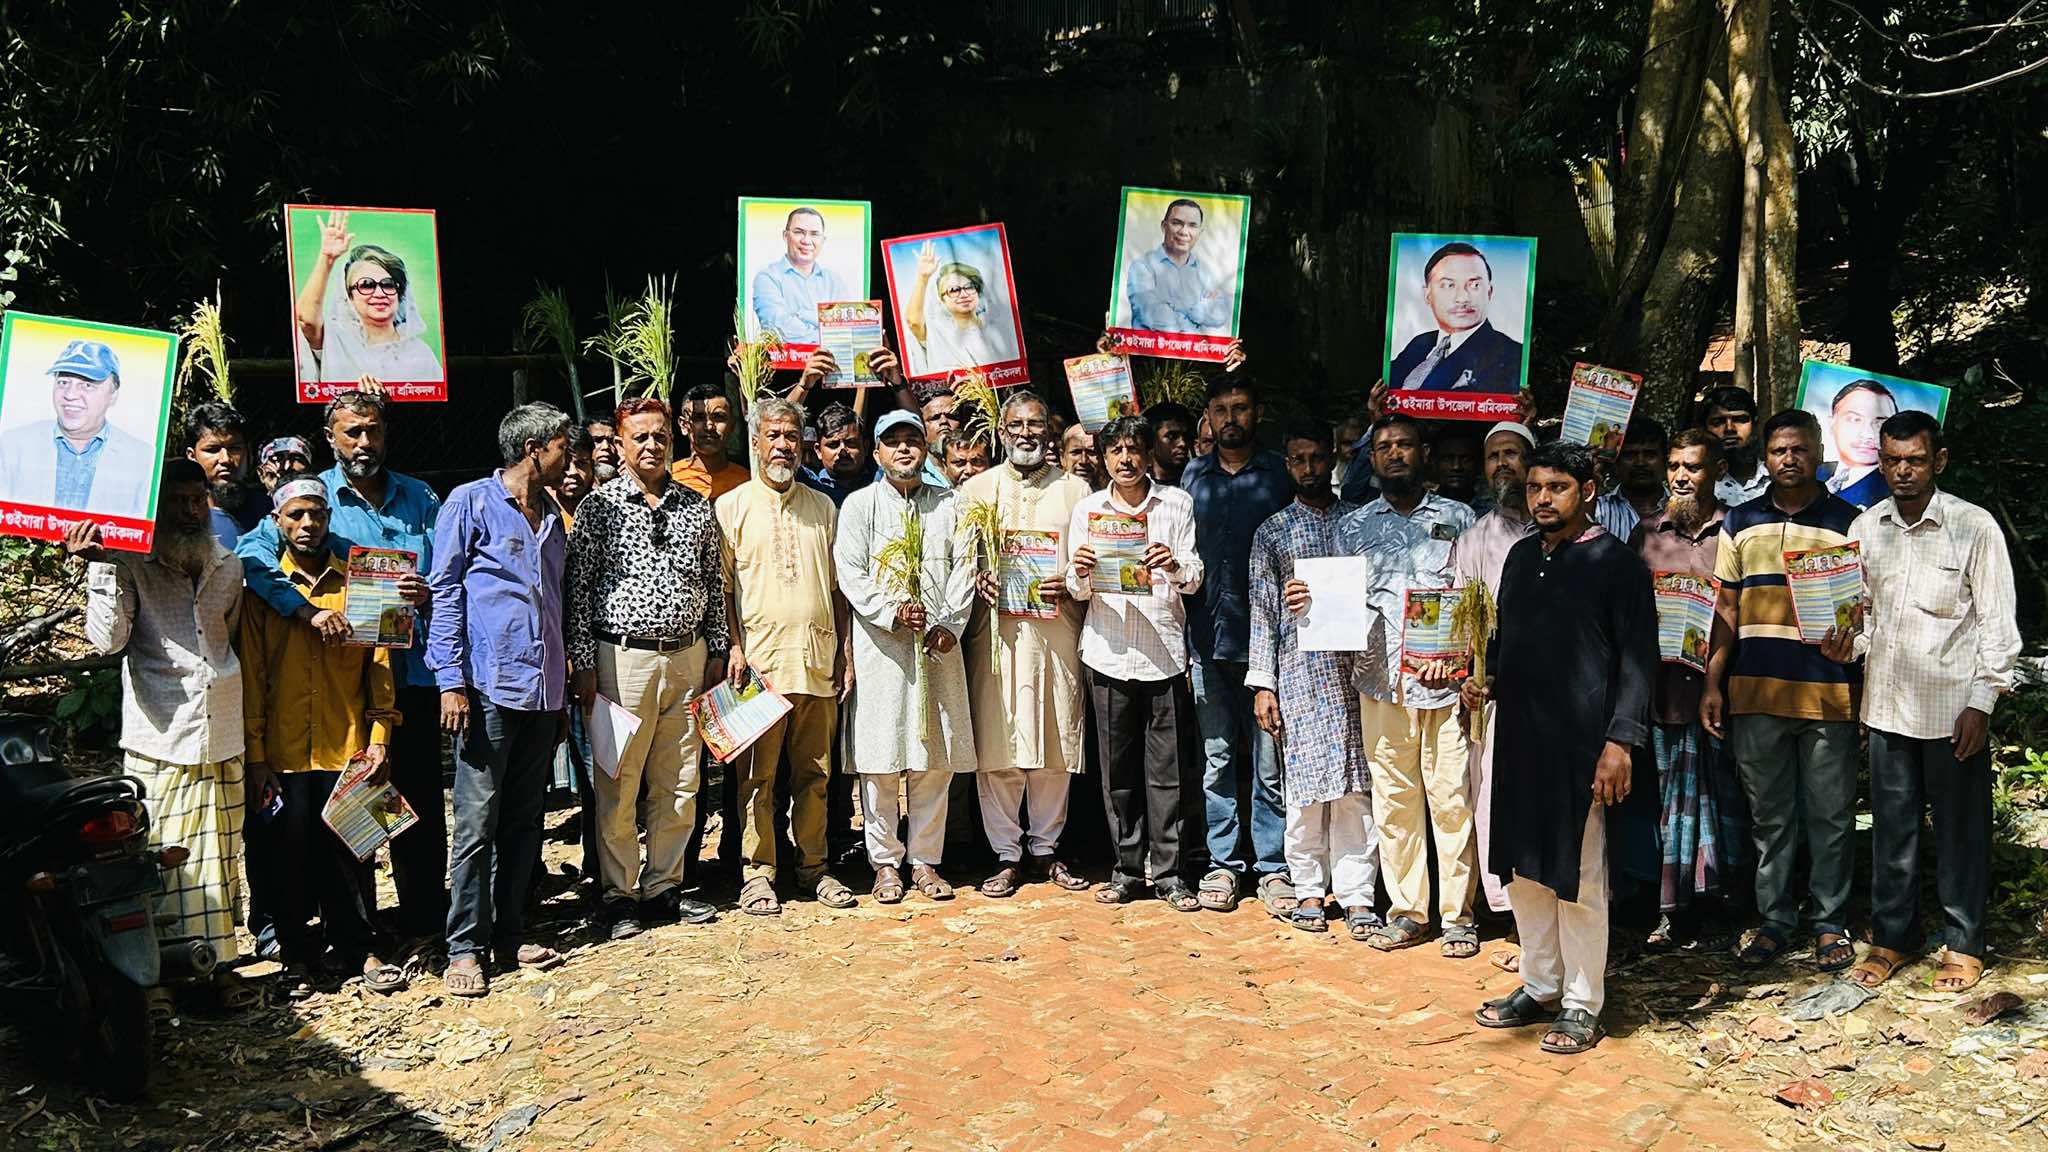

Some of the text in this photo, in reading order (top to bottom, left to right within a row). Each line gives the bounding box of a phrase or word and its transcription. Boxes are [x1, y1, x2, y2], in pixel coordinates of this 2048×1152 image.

[1126, 335, 1155, 349] গুইমারা
[1158, 337, 1192, 352] উপজেলা
[398, 383, 436, 396] শ্রমিকদল
[1402, 396, 1434, 411] গুইমারা
[1437, 397, 1475, 413] উপজেলা
[5, 509, 44, 531] গুইমারা
